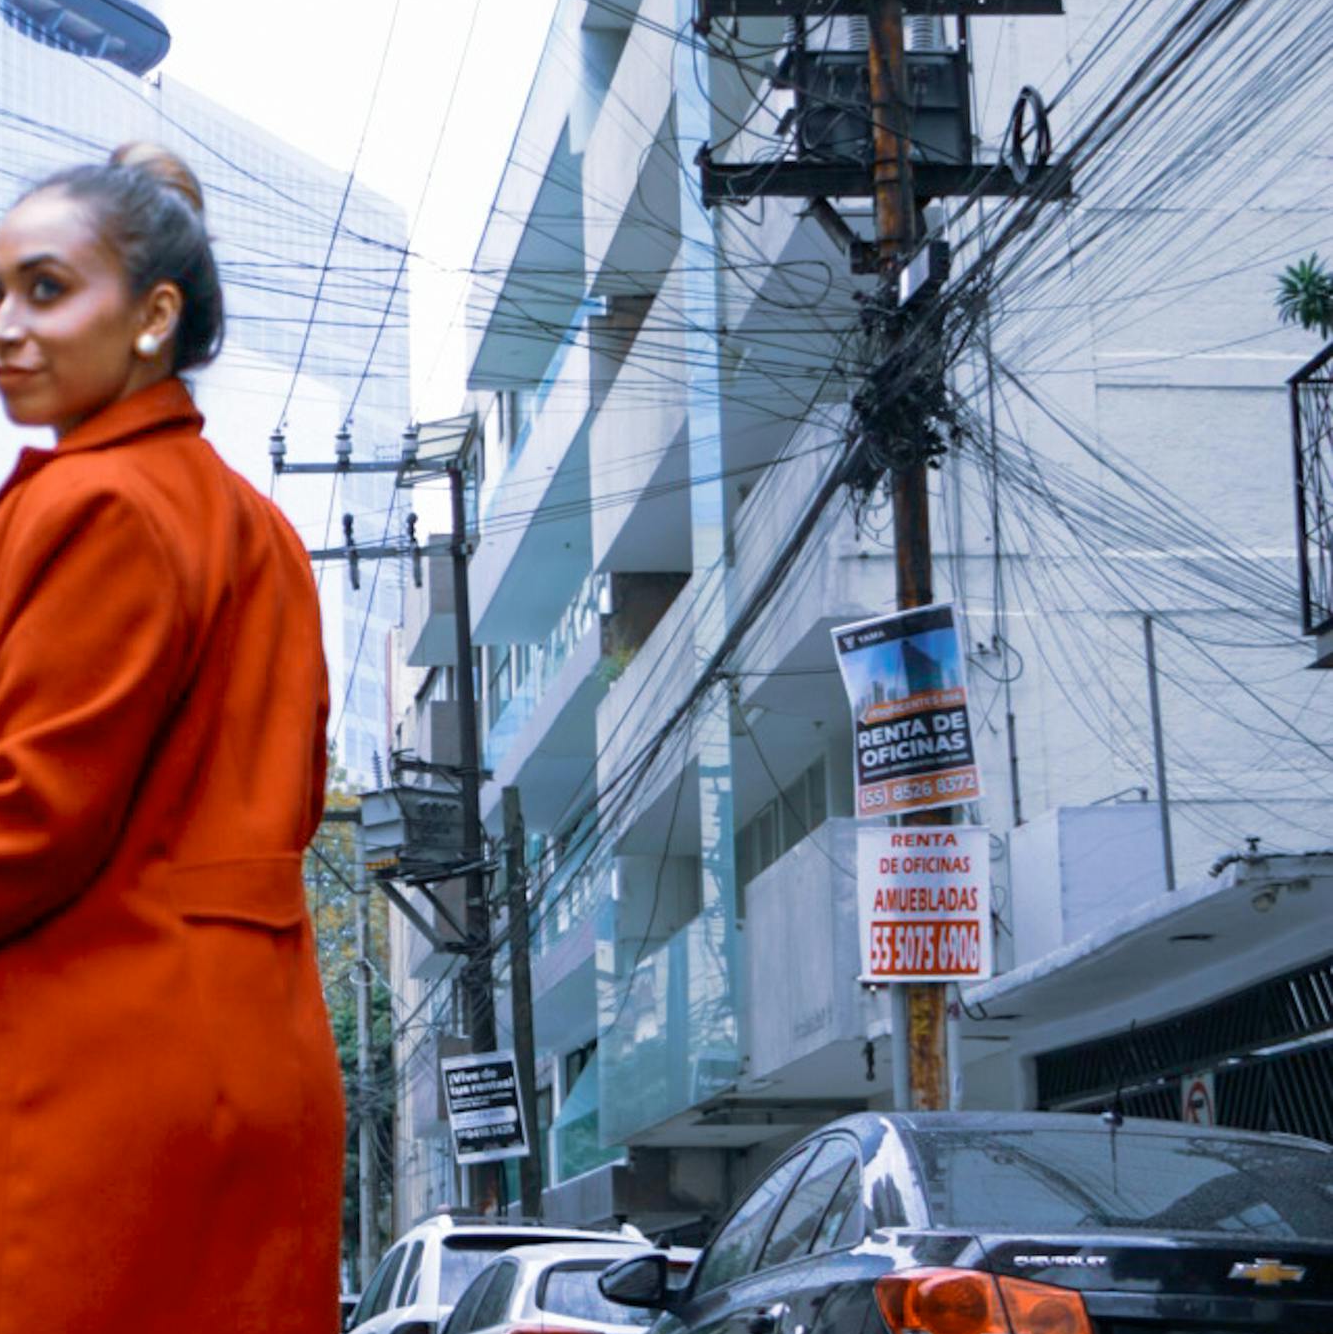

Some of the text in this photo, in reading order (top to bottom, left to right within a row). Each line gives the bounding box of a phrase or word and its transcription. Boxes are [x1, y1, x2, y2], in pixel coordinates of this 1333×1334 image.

[858, 712, 966, 749] RENTA DE
[861, 732, 966, 767] OFICINAS
[892, 780, 932, 802] 8526
[891, 833, 958, 847] RENTA
[879, 856, 971, 874] DE OFICINAS
[874, 887, 978, 912] AMUEBLADAS
[871, 923, 979, 970] 55 5075 6906
